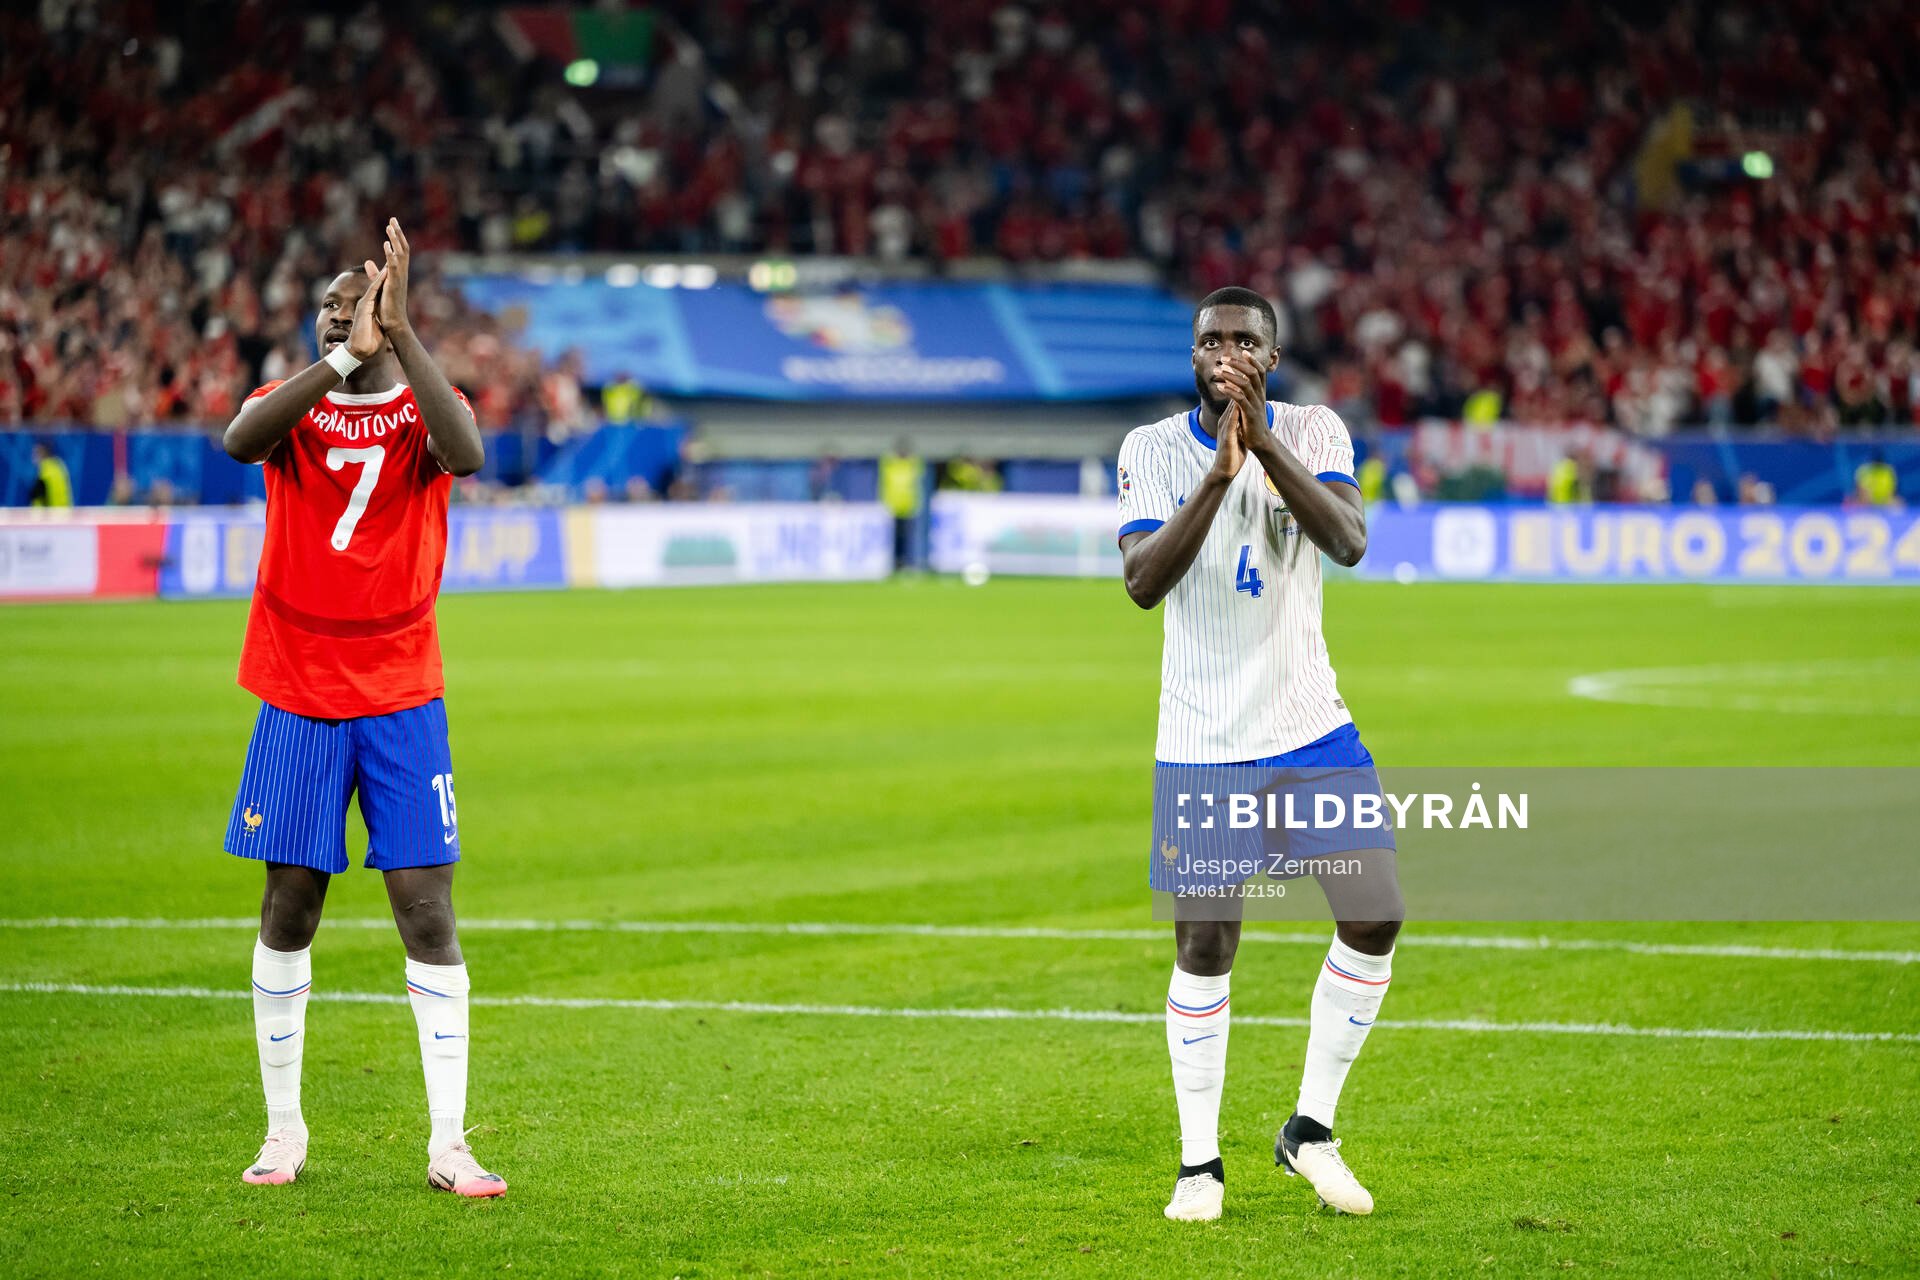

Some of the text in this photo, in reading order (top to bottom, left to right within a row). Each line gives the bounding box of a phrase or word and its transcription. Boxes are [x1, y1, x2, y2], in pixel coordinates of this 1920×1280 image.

[326, 445, 385, 551] 7
[1235, 545, 1264, 598] 4
[1510, 511, 1725, 575] EURO
[431, 773, 457, 827] 15
